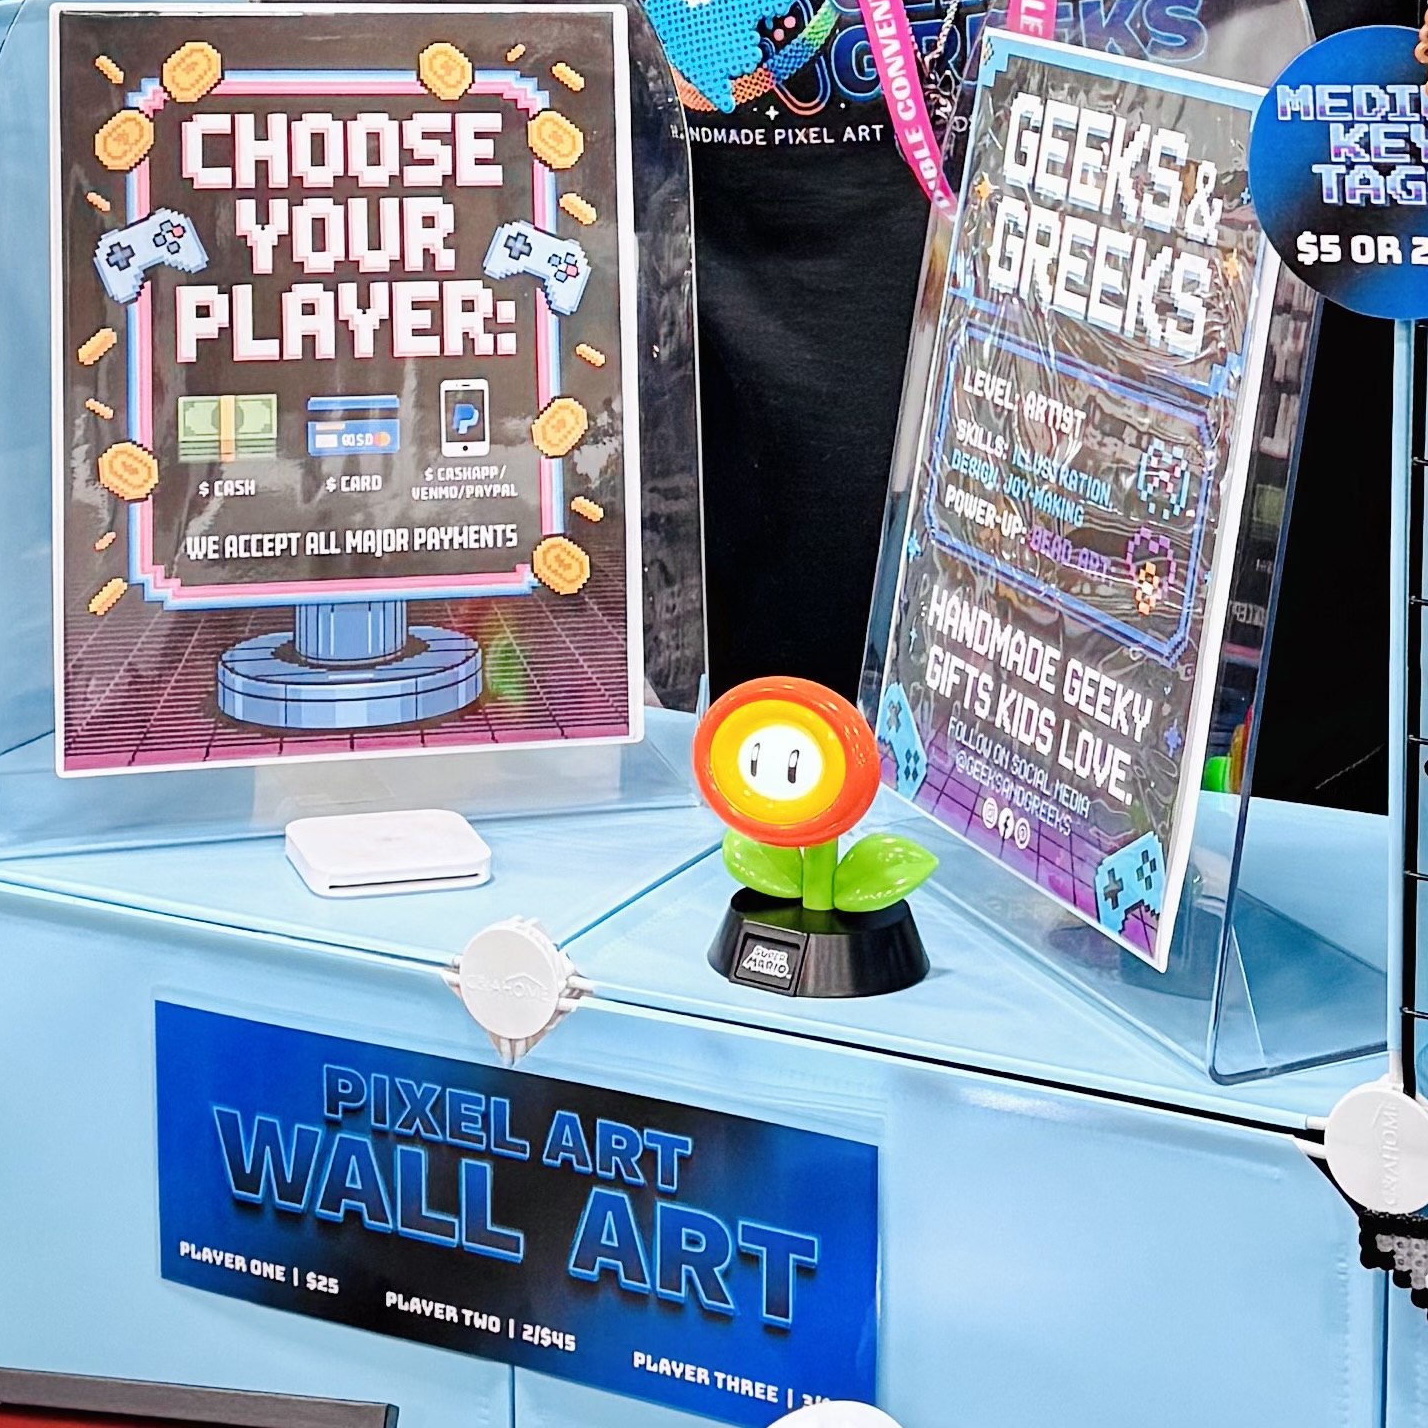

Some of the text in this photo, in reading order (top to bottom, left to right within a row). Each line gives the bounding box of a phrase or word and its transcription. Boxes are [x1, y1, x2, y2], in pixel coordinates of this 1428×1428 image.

[181, 112, 503, 190] CHOOSE
[670, 124, 885, 146] HNDMADE PIXEL ART
[236, 196, 456, 275] YOUR
[1296, 230, 1342, 266] $5
[1350, 234, 1403, 264] OR
[988, 195, 1212, 360] GREEKS
[176, 278, 517, 363] PLAYER:
[962, 366, 1020, 410] LEVEL:
[956, 418, 1009, 460] SKILLS:
[214, 479, 256, 497] CASH
[341, 474, 383, 493] CARD
[412, 484, 518, 501] VENMO/PAYPAL
[944, 484, 1027, 544] POWER-UP:
[1003, 475, 1086, 528] JOY-MAKING
[186, 524, 518, 561] WE ACCEPT ALL MAJOR PAYMENTS
[928, 585, 1154, 742] HANDMADE GEEKY
[925, 646, 1133, 806] GIFTS KIDS LOVE.
[947, 716, 1091, 819] FOLLOW ON SOCIAL MEDIA
[955, 749, 1073, 837] @GEEKSANDGREEKS
[744, 956, 788, 976] MARIO
[322, 1063, 692, 1193] PIXEL ART
[213, 1103, 820, 1330] WALL ART
[179, 1240, 247, 1273] PLAYER
[250, 1258, 286, 1283] ONE
[305, 1271, 340, 1295] $25
[385, 1290, 459, 1324] PLAYER
[461, 1308, 502, 1334] TWO
[521, 1323, 577, 1353] 2/$45
[633, 1351, 710, 1386] PLAYER
[714, 1371, 779, 1404] THREE
